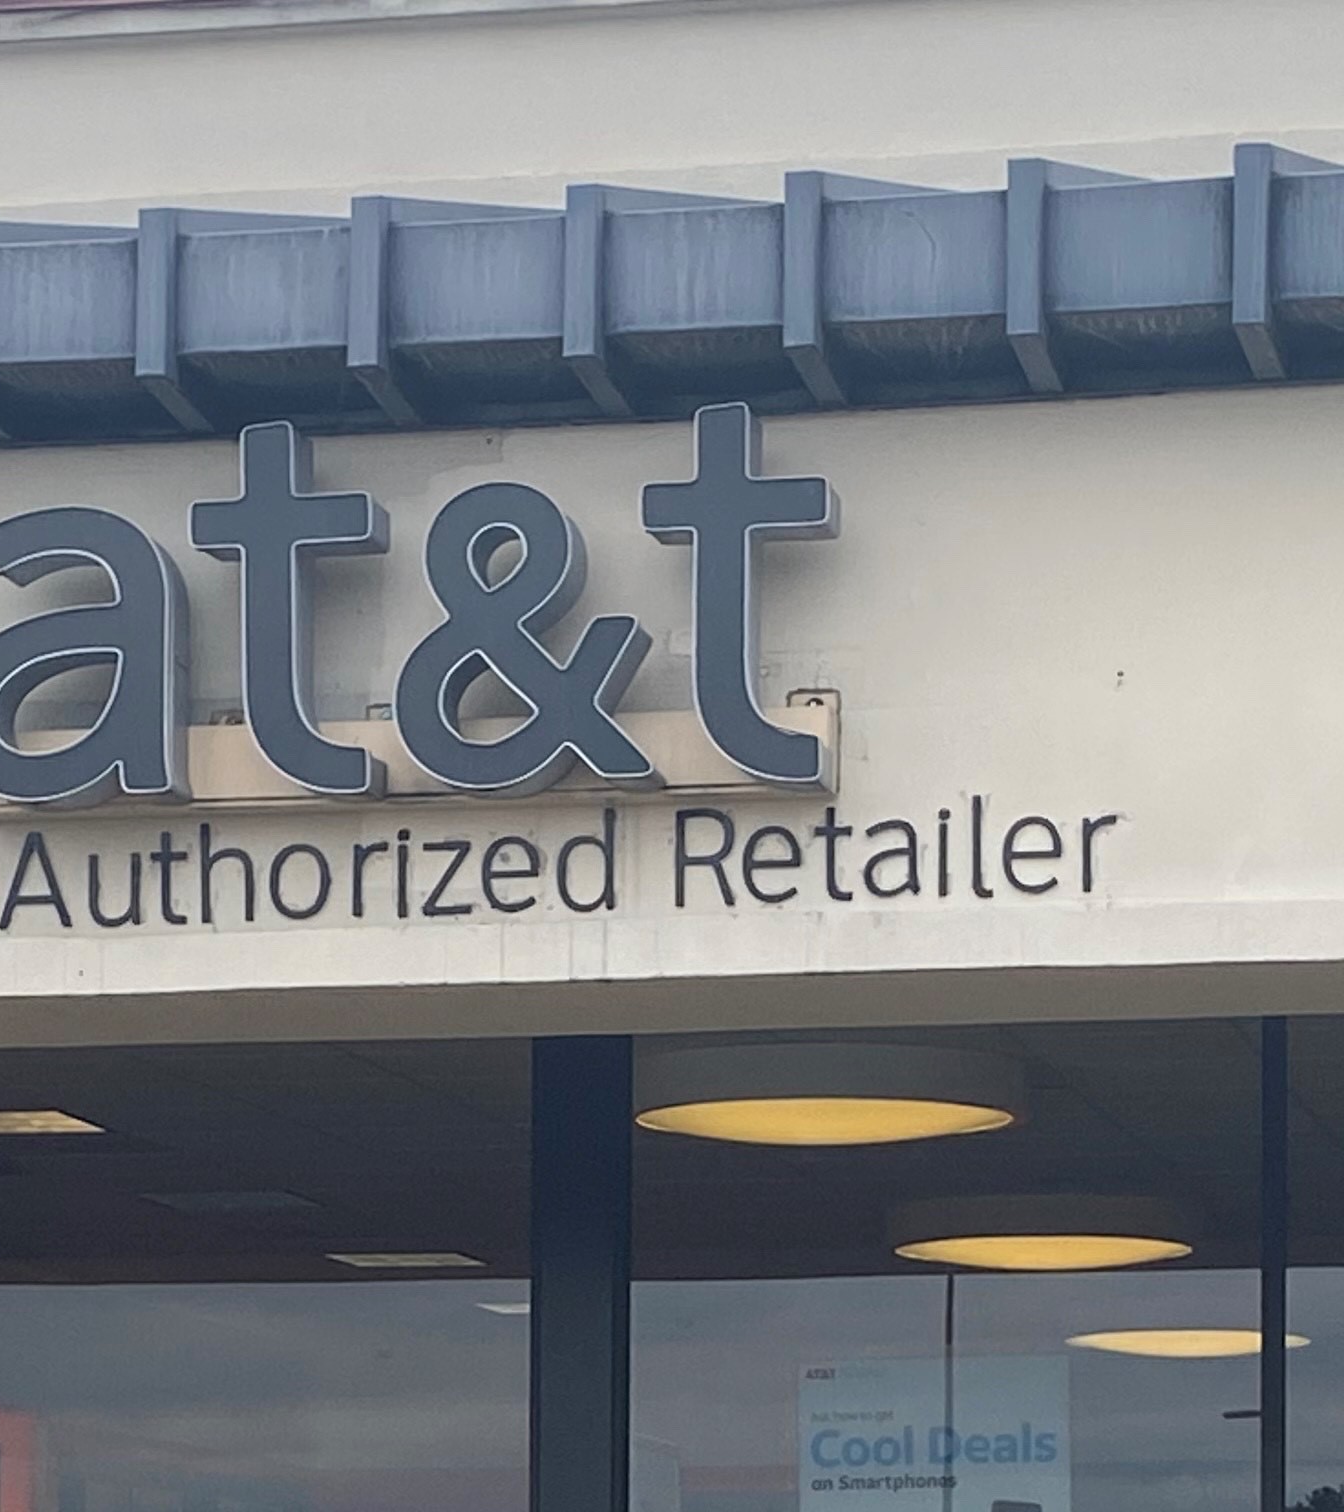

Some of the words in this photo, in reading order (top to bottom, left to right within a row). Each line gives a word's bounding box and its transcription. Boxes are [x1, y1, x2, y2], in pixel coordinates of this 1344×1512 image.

[674, 795, 1119, 907] Retailer
[810, 1425, 915, 1468] Cool
[928, 1421, 1058, 1464] Deals
[811, 1477, 833, 1491] on
[838, 1474, 957, 1493] Smartphones
